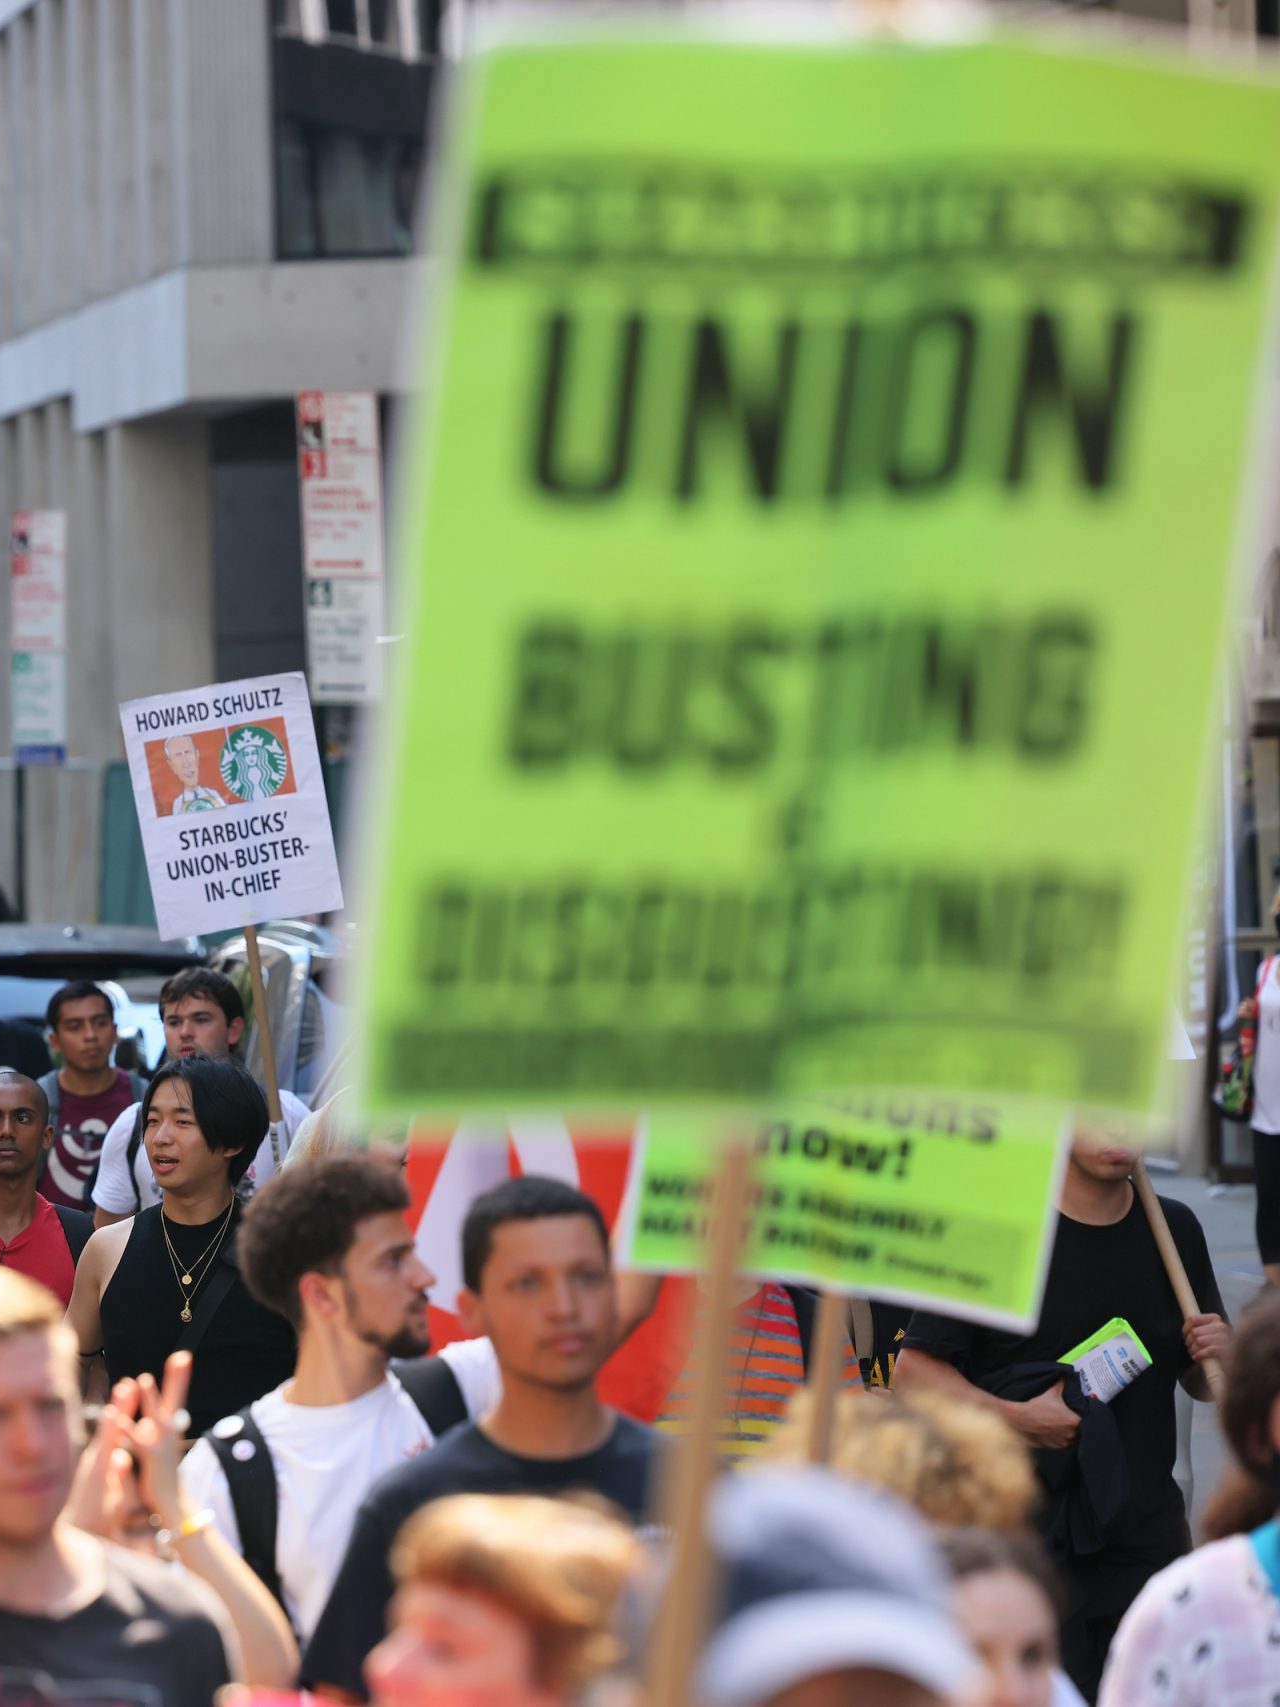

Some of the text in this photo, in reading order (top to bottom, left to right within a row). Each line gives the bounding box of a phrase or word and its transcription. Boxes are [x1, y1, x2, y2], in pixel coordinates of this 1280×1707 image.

[529, 304, 1145, 507] UNION
[135, 687, 283, 732] HOWARD SCHULTZ
[506, 604, 1100, 775] BUSTING
[179, 811, 288, 850] STARBUCKS'
[166, 837, 310, 880] UNION-BUSTER-
[204, 869, 281, 902] IN-CHIEF
